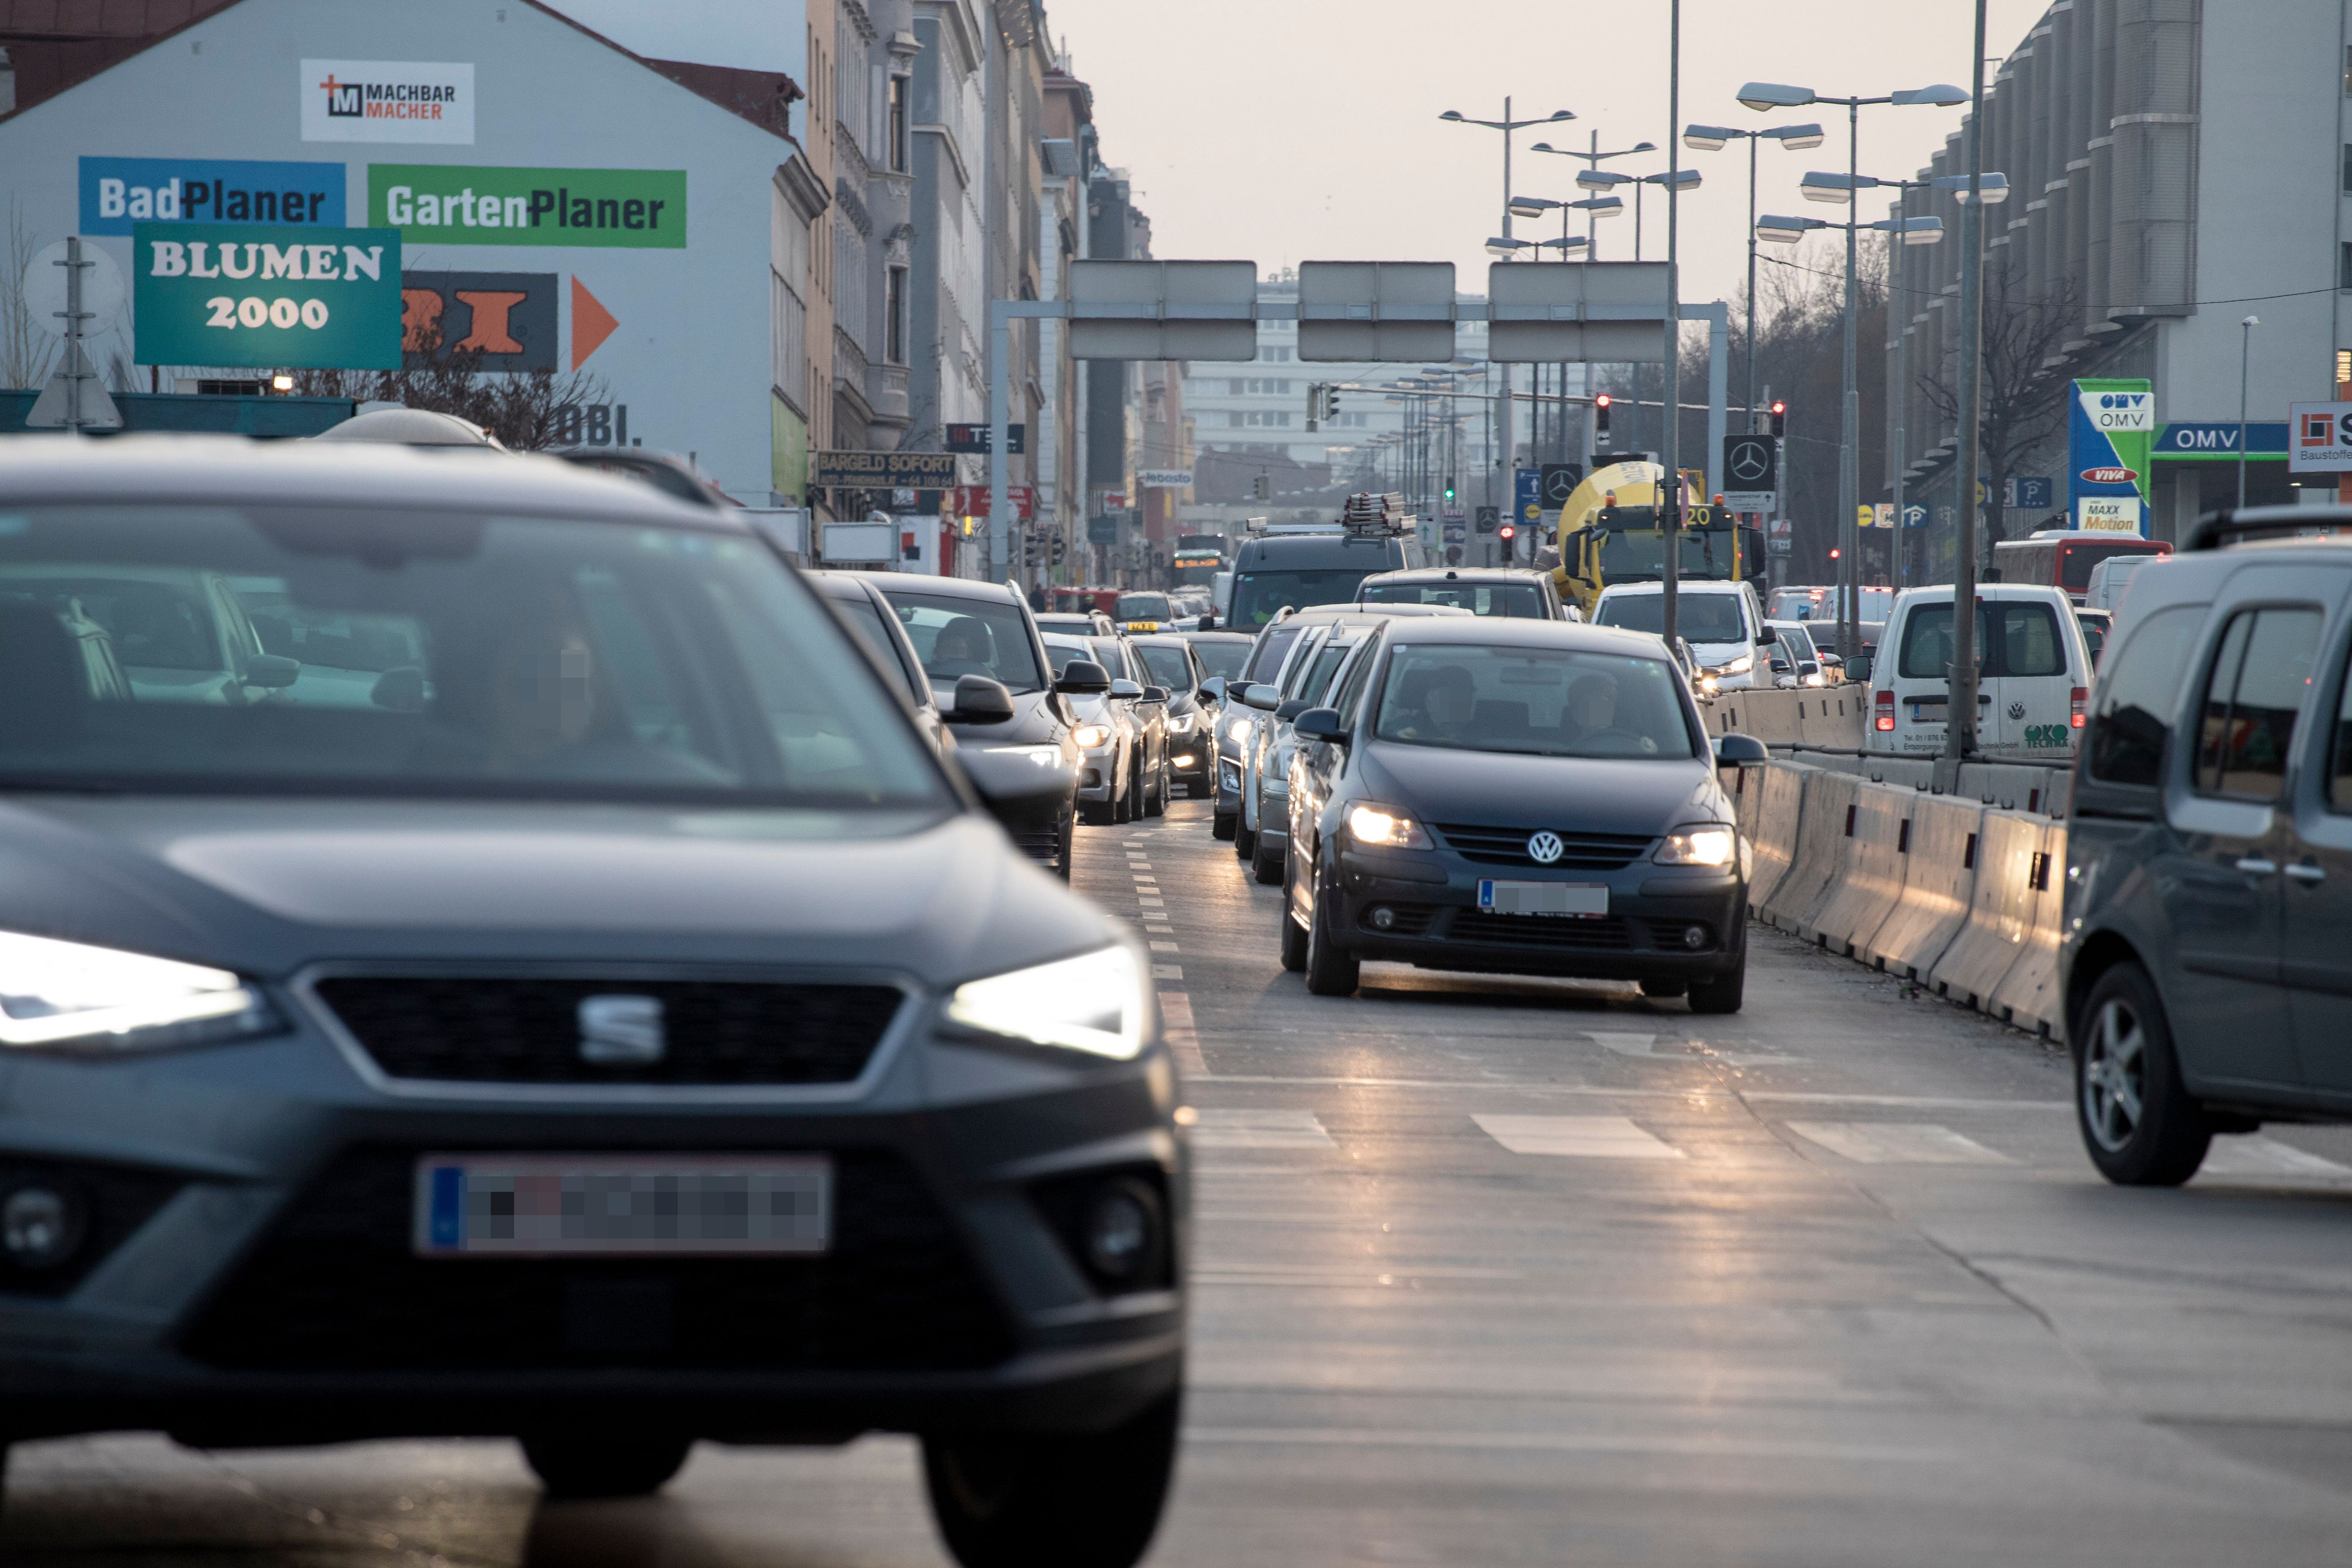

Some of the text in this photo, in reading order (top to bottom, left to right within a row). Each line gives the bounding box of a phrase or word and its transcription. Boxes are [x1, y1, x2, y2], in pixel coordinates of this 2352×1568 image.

[366, 83, 456, 103] MACHBAR
[366, 102, 443, 120] MACHER
[99, 178, 326, 223] BadPlaner
[387, 186, 665, 230] GartenPlaner
[150, 240, 384, 282] BLUMEN
[205, 296, 329, 330] 2000
[2100, 413, 2144, 427] OMV
[2176, 430, 2237, 448] OMV
[818, 454, 954, 473] BARGELD SOFORT
[2300, 449, 2352, 460] Baustoffe
[2095, 470, 2126, 480] VIVA
[1687, 507, 1710, 526] 20
[2089, 505, 2120, 515] MAXX
[2084, 516, 2134, 530] Motion
